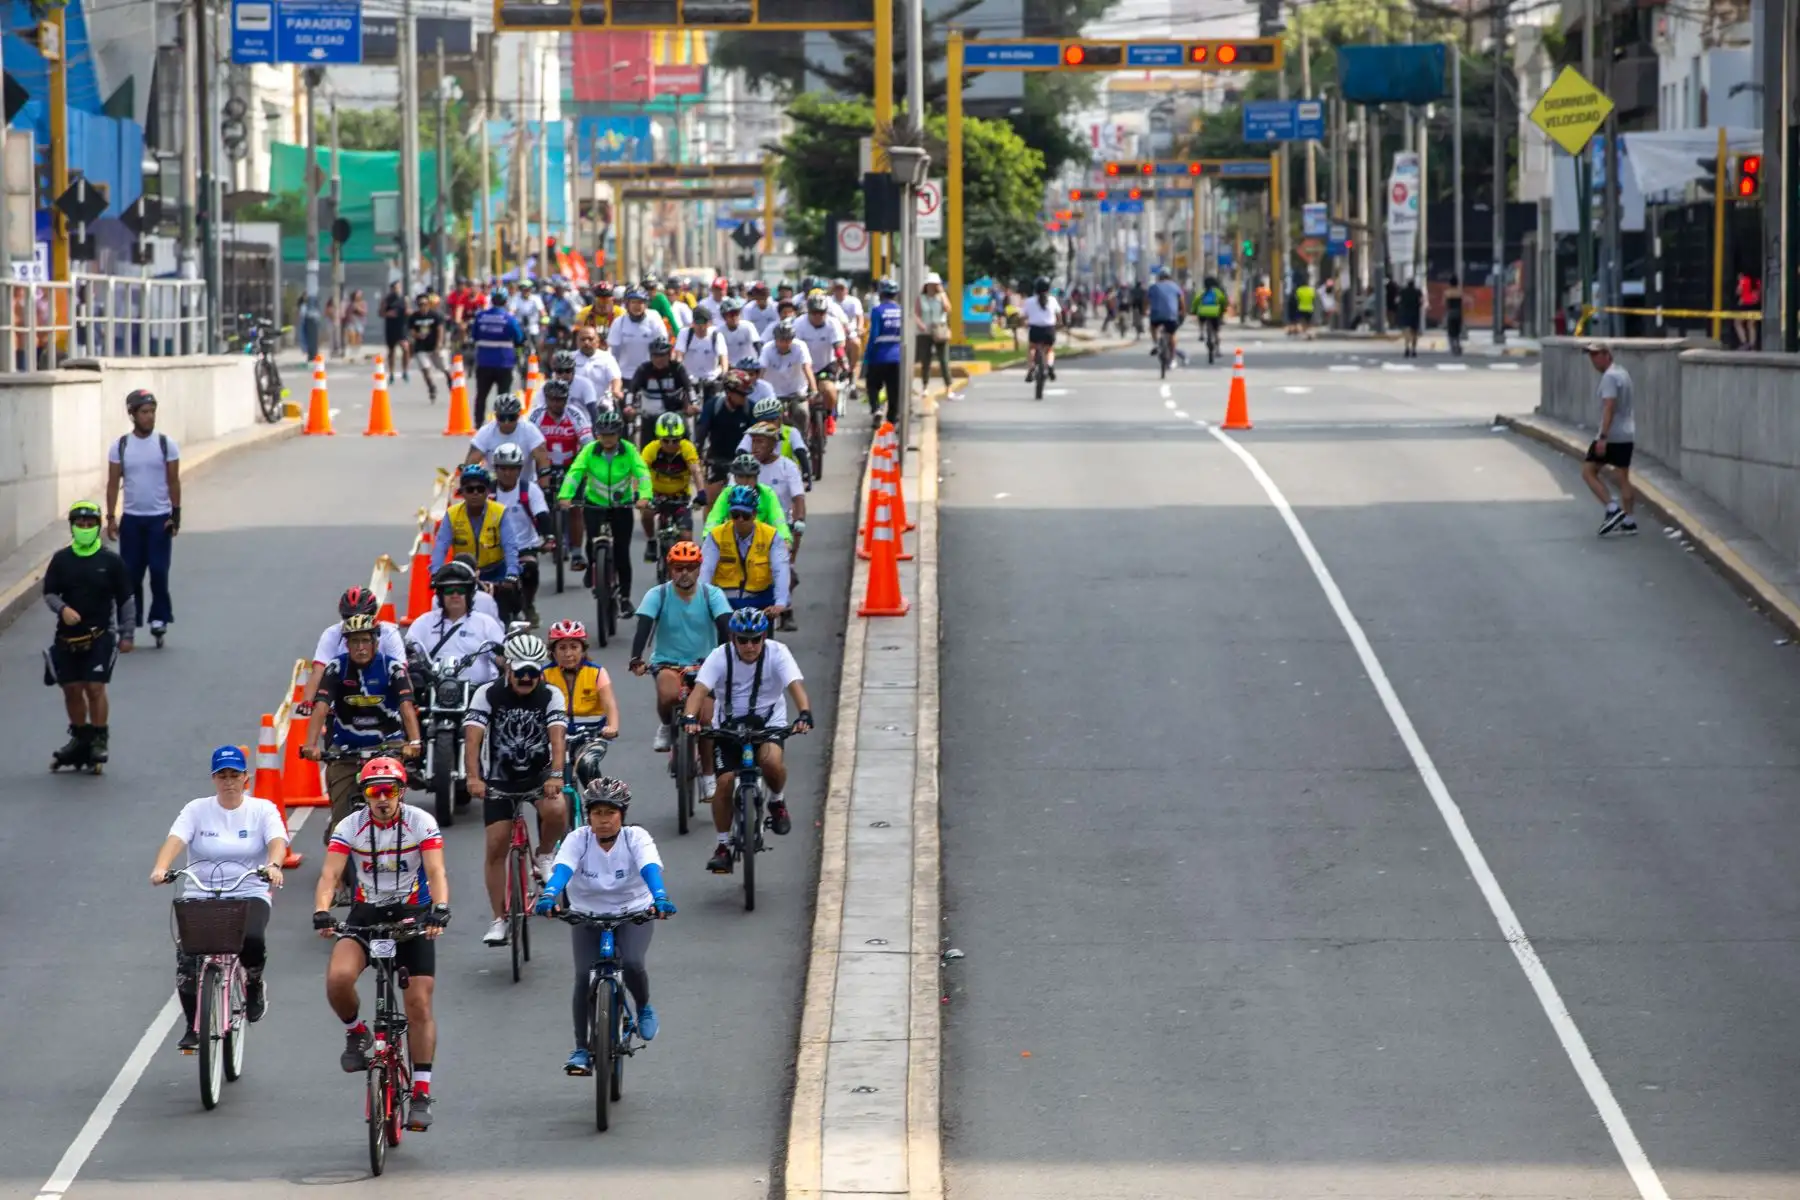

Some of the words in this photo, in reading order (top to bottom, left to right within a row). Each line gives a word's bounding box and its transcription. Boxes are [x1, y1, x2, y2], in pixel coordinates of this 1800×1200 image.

[286, 18, 352, 31] PARADERO
[1544, 93, 1598, 112] DISMINUIR
[1544, 111, 1601, 128] VELOCIDAD
